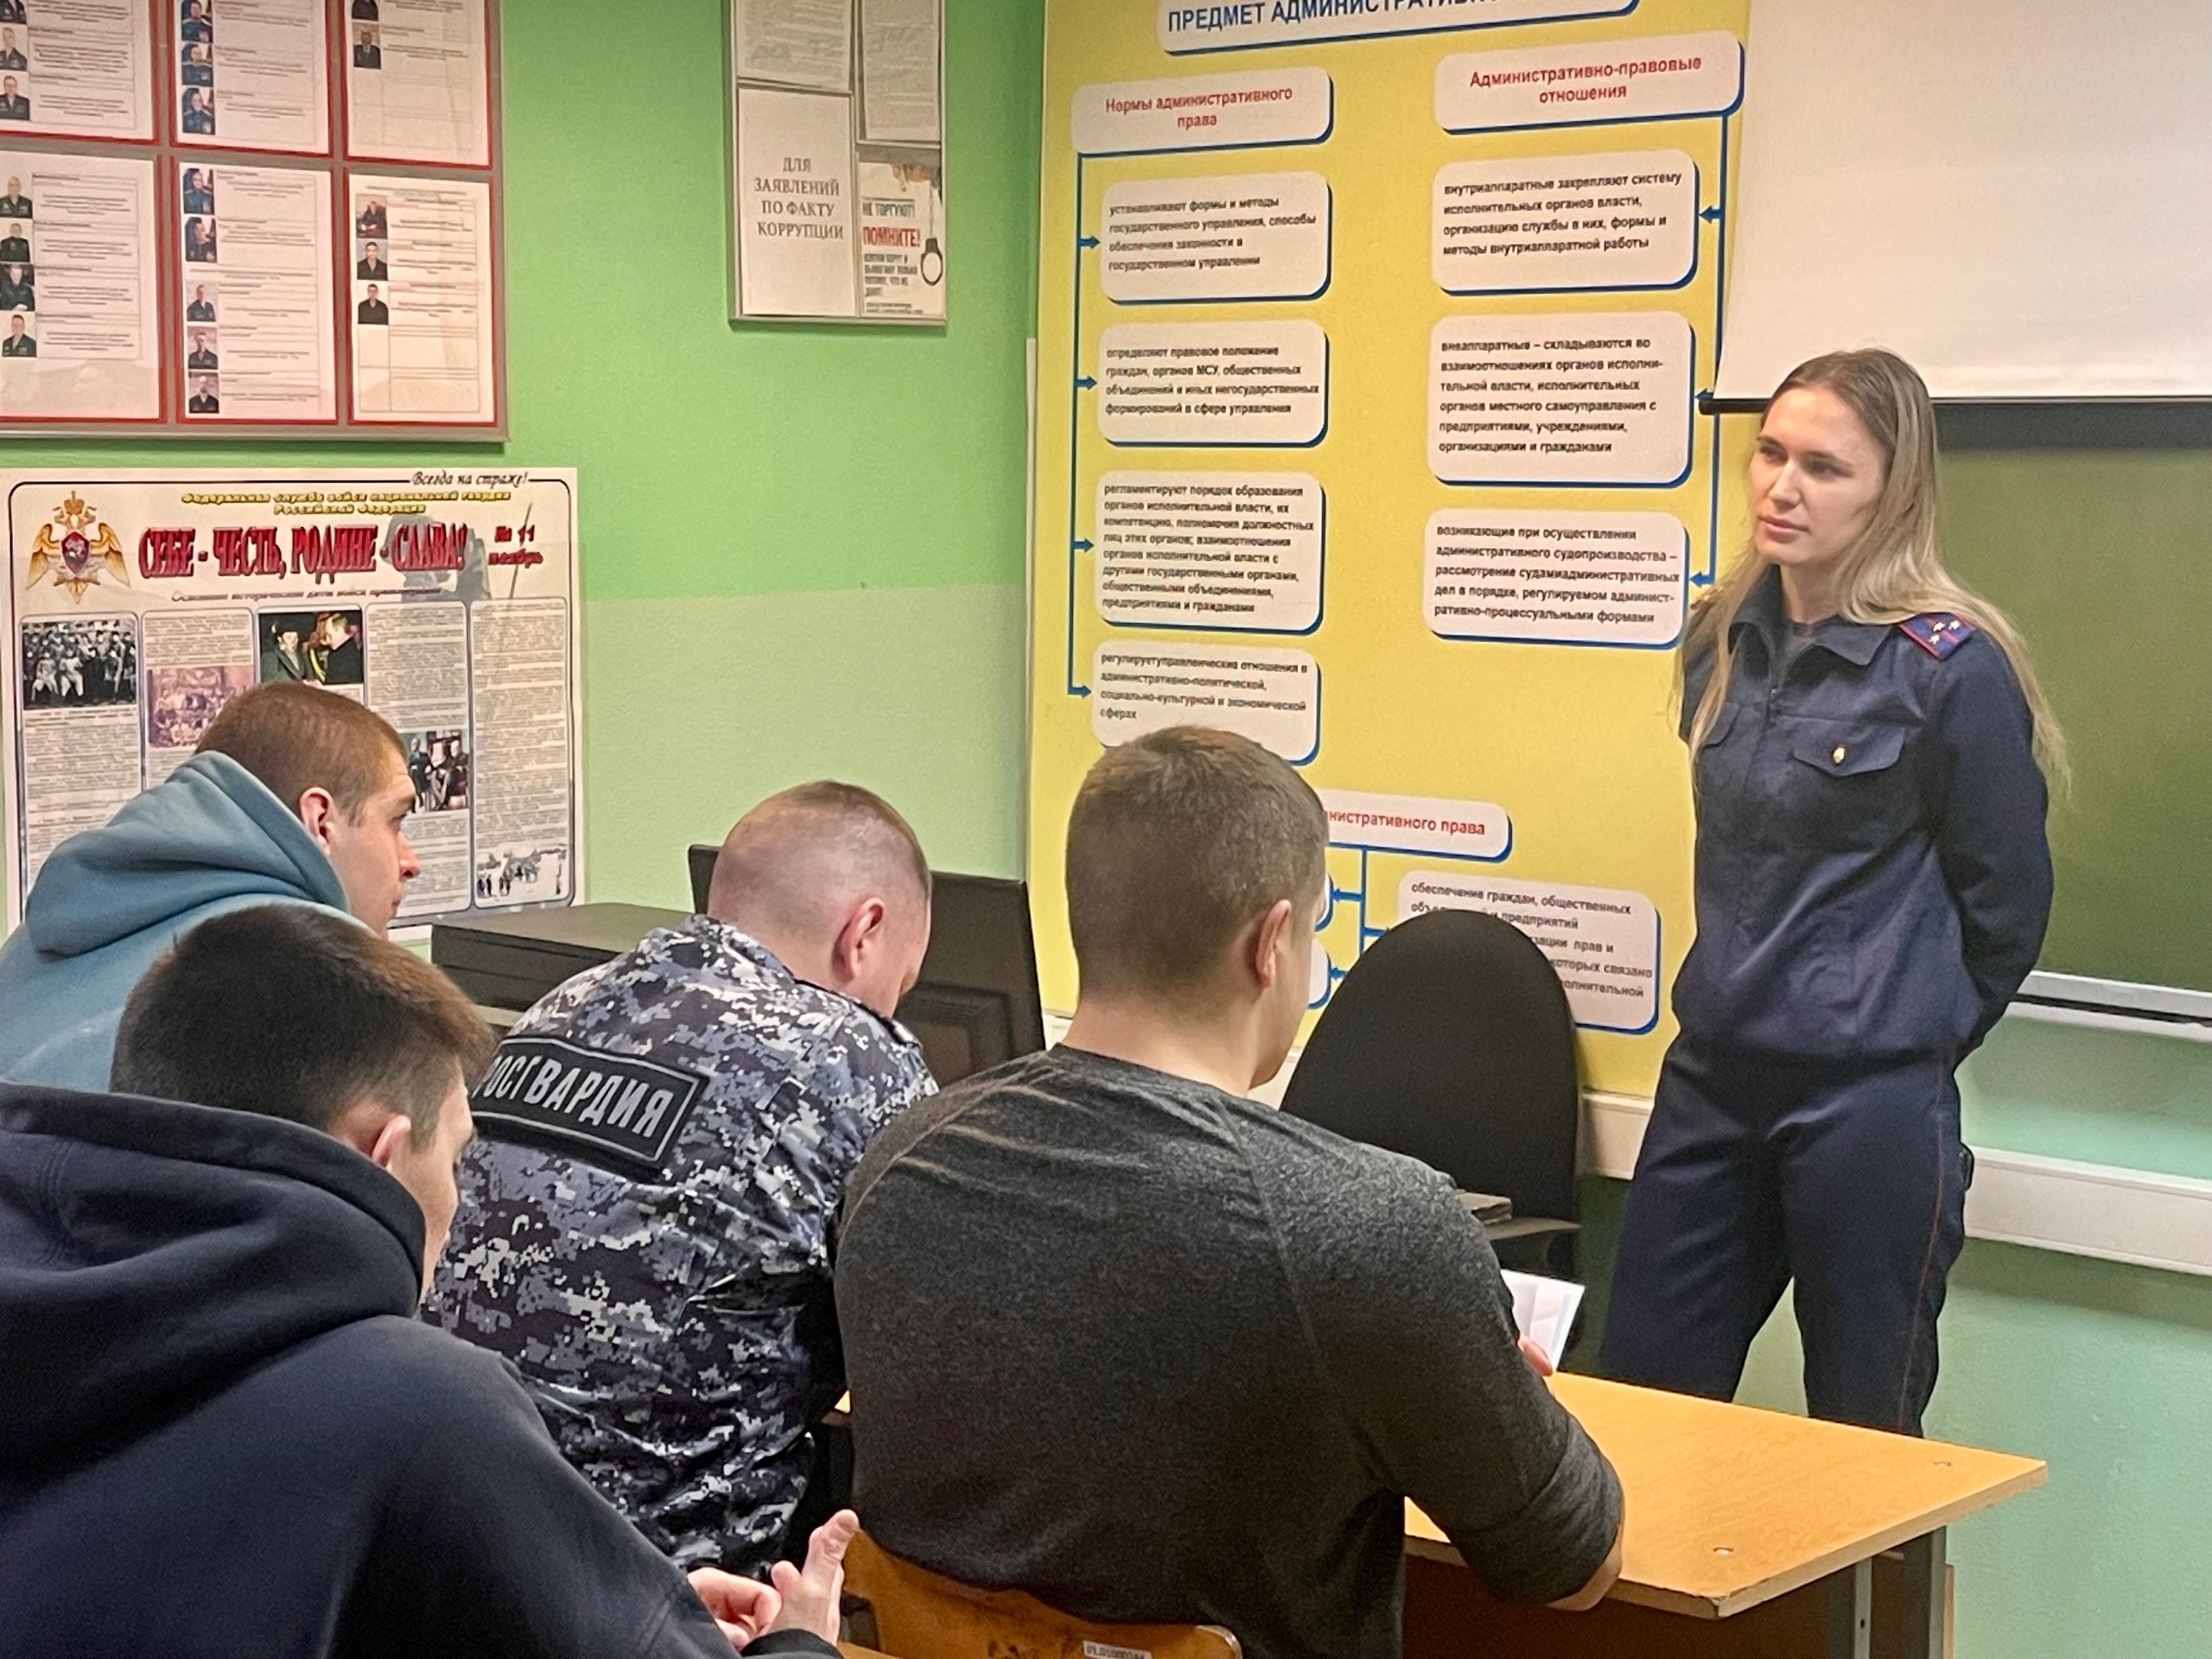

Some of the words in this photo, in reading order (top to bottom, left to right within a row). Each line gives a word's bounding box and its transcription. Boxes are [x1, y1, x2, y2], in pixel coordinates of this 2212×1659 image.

[1168, 3, 1263, 31] ПРЕДМЕТ
[1470, 58, 1701, 87] Административно-правовые
[1106, 99, 1152, 114] Нормы
[1156, 88, 1293, 111] административного
[1540, 86, 1627, 104] отношения
[1178, 114, 1217, 130] права
[783, 157, 810, 173] ДЛЯ
[754, 177, 839, 195] ЗАЯВЛЕНИЙ
[1445, 180, 1554, 196] внутриаппаратные
[1558, 176, 1628, 190] закрепляют
[1631, 173, 1681, 186] систему
[762, 200, 783, 214] ПО
[787, 201, 835, 216] ФАКТУ
[1444, 202, 1542, 215] исполнительных
[1546, 199, 1593, 213] органов
[1598, 196, 1642, 208] власти,
[758, 222, 843, 239] КОРРУПЦИИ
[1444, 223, 1518, 237] организацию
[1522, 219, 1568, 234] службы
[1611, 218, 1655, 231] формы
[1659, 216, 1666, 226] и
[862, 226, 920, 247] ПОМНИТЕ!
[1444, 245, 1486, 256] методы
[1491, 238, 1599, 256] внутриаппаратной
[1604, 237, 1649, 251] работы
[1441, 342, 1530, 353] внеаппаратные
[1544, 340, 1631, 350] складываются
[1636, 339, 1650, 348] во
[1441, 361, 1552, 372] взаимоотношениях
[1556, 360, 1604, 372] органов
[1441, 381, 1487, 391] тельной
[1491, 382, 1534, 392] власти,
[1537, 381, 1640, 391] исполнительных
[1440, 401, 1485, 413] органов
[1489, 402, 1542, 410] местного
[1546, 401, 1645, 413] самоуправления
[1440, 423, 1533, 434] предприятиями,
[1536, 423, 1626, 434] учреждениями,
[1440, 442, 1526, 453] организациями
[1529, 442, 1536, 451] и
[1540, 442, 1611, 454] гражданами
[412, 472, 454, 486] Всегда
[458, 475, 472, 485] на
[1437, 527, 1514, 537] возникающие
[1518, 529, 1539, 539] при
[1543, 529, 1636, 541] осуществлении
[139, 526, 195, 579] СЕБЕ
[213, 525, 286, 579] ЧЕСТЬ,
[290, 524, 378, 584] РОДИНЕ
[393, 523, 467, 571] СЛАВА!
[1437, 546, 1550, 558] административного
[1554, 550, 1666, 562] судопроизводства
[1436, 566, 1516, 577] рассмотрение
[1434, 586, 1455, 596] дел
[1470, 588, 1519, 599] порядке,
[1522, 589, 1606, 601] регулируемом
[1185, 601, 1190, 610] и
[1434, 606, 1593, 621] ративно-процессуальными
[1597, 611, 1654, 624] формами
[1329, 810, 1436, 832] нистративного
[1441, 822, 1485, 836] права
[1411, 882, 1483, 899] обеспечение
[1541, 895, 1630, 914] общественных
[1574, 941, 1601, 953] прав
[1605, 964, 1651, 978] связано
[1564, 981, 1643, 997] олнительной
